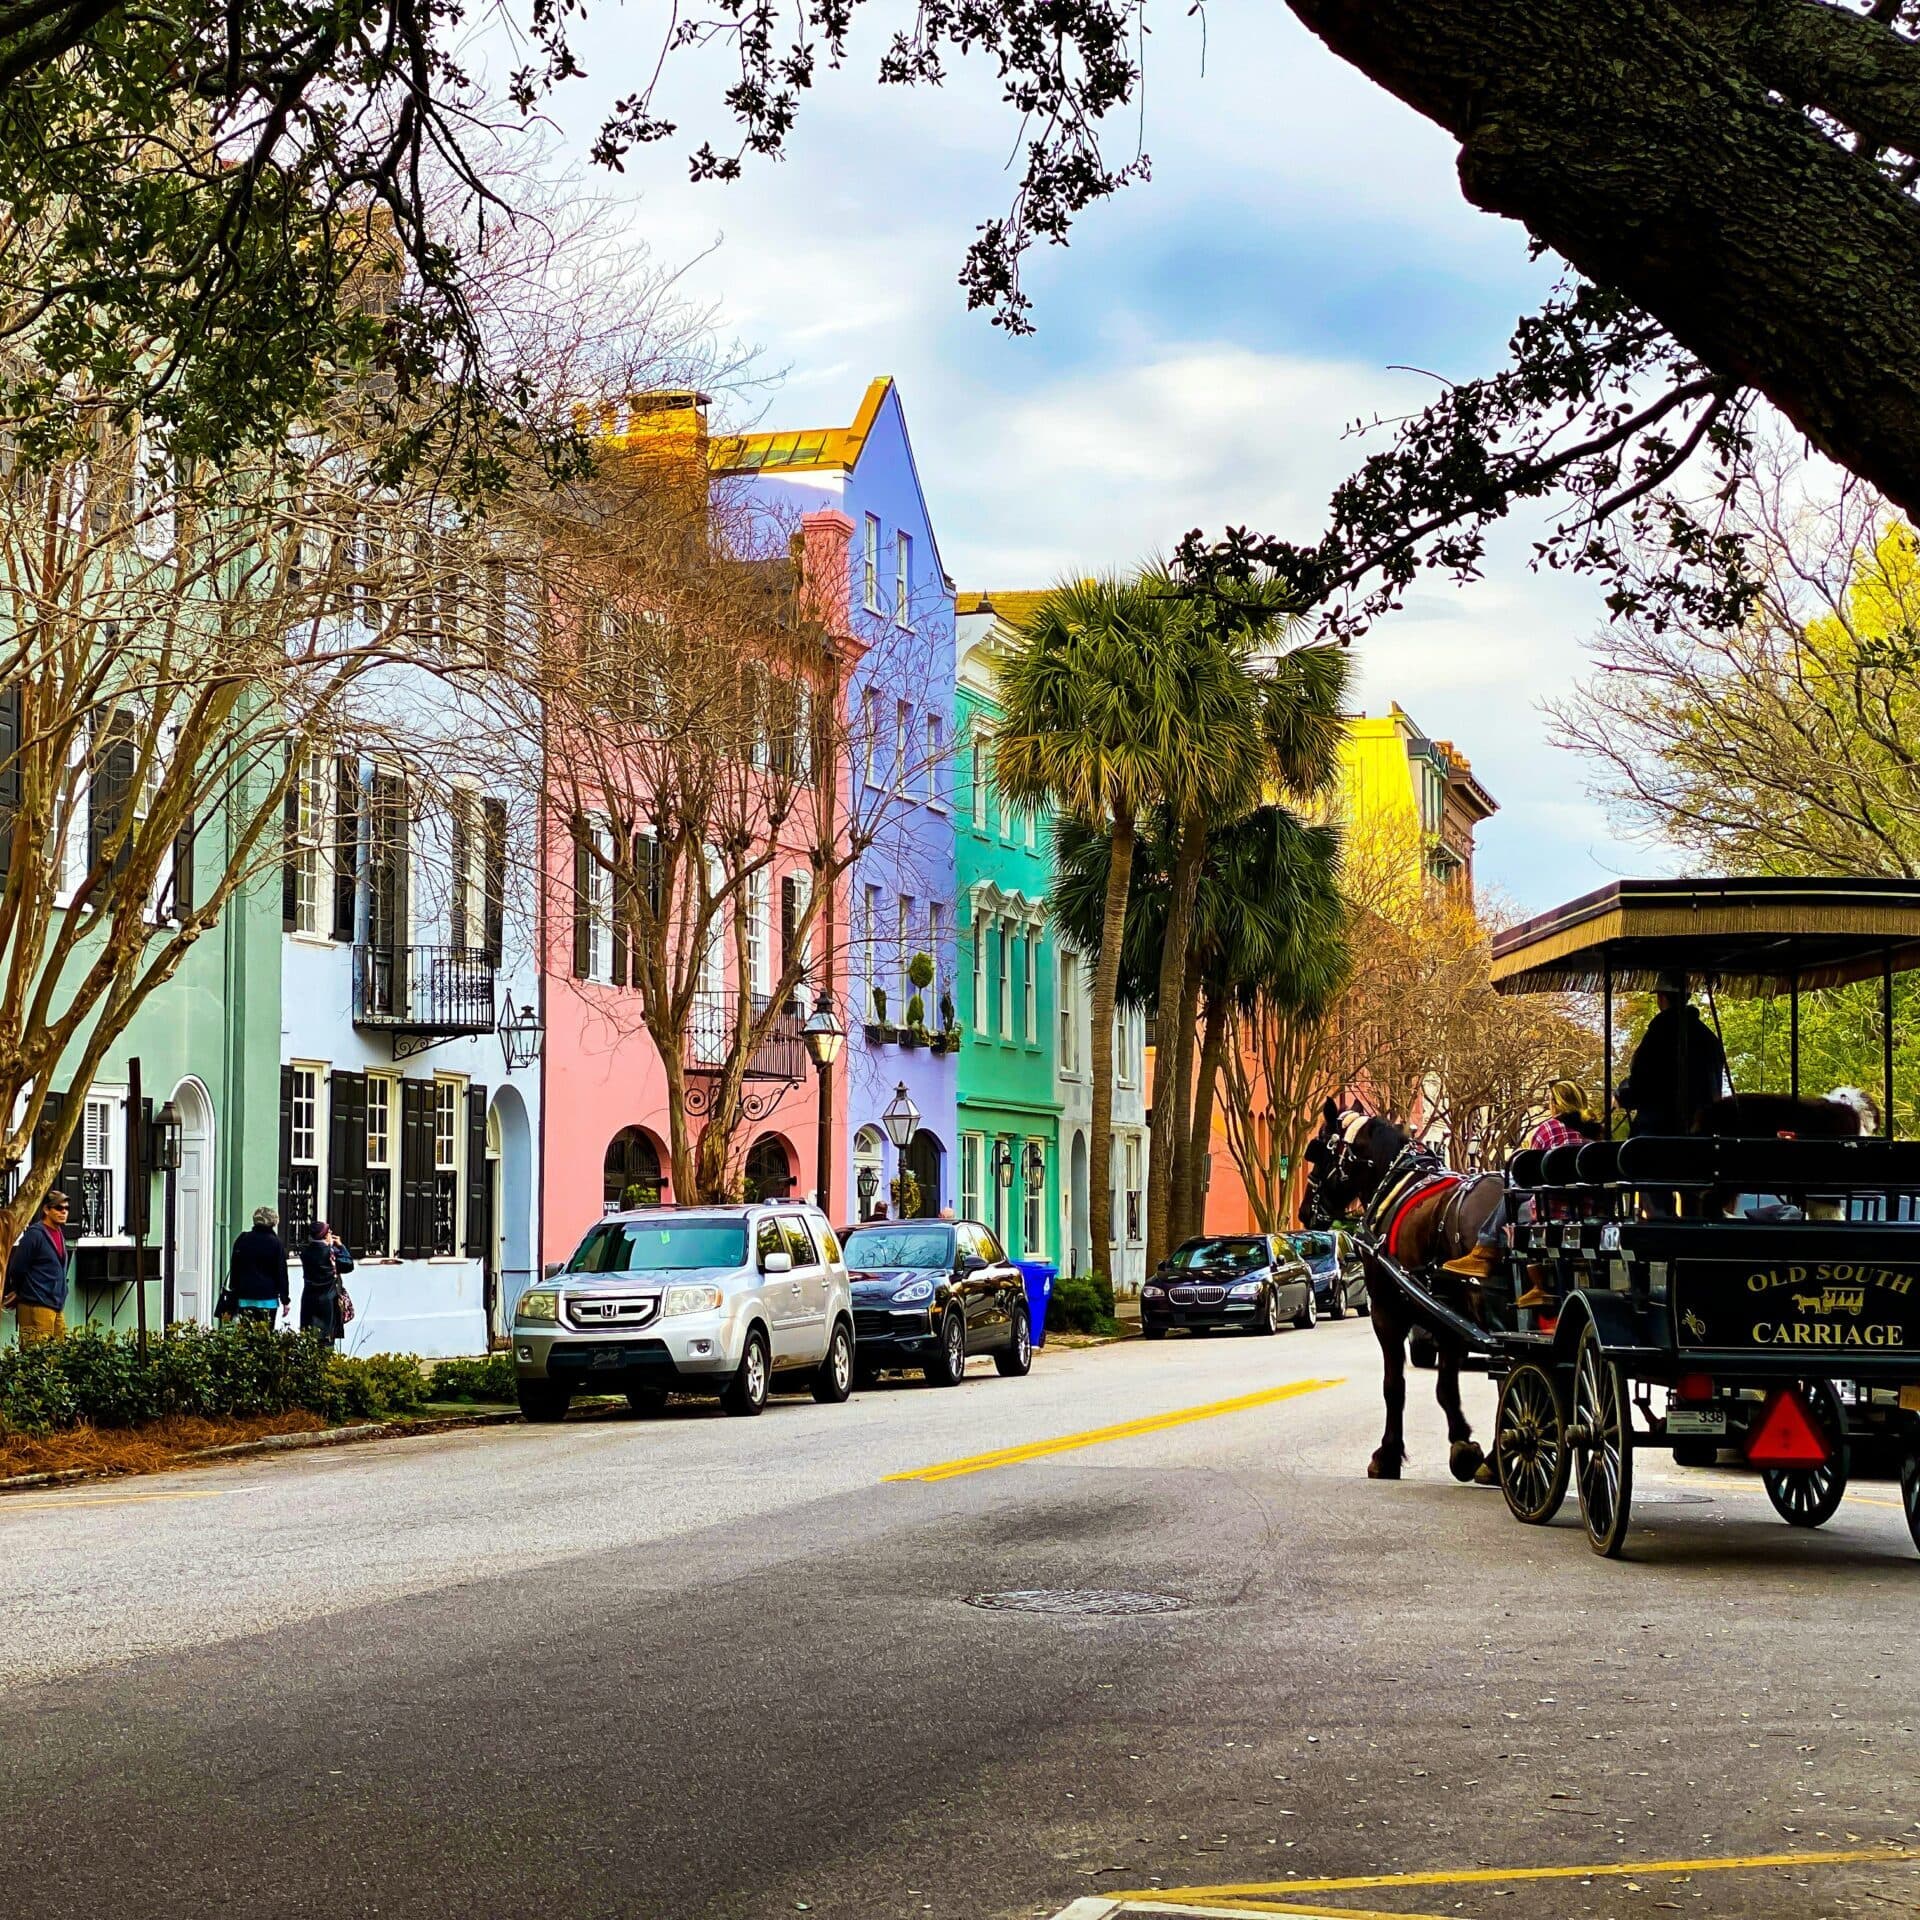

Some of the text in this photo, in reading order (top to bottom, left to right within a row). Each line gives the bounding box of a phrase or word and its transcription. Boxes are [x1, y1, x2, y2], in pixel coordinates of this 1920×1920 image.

[1747, 1264, 1913, 1295] OLD SOUTH
[1752, 1322, 1903, 1346] CARRIAGE
